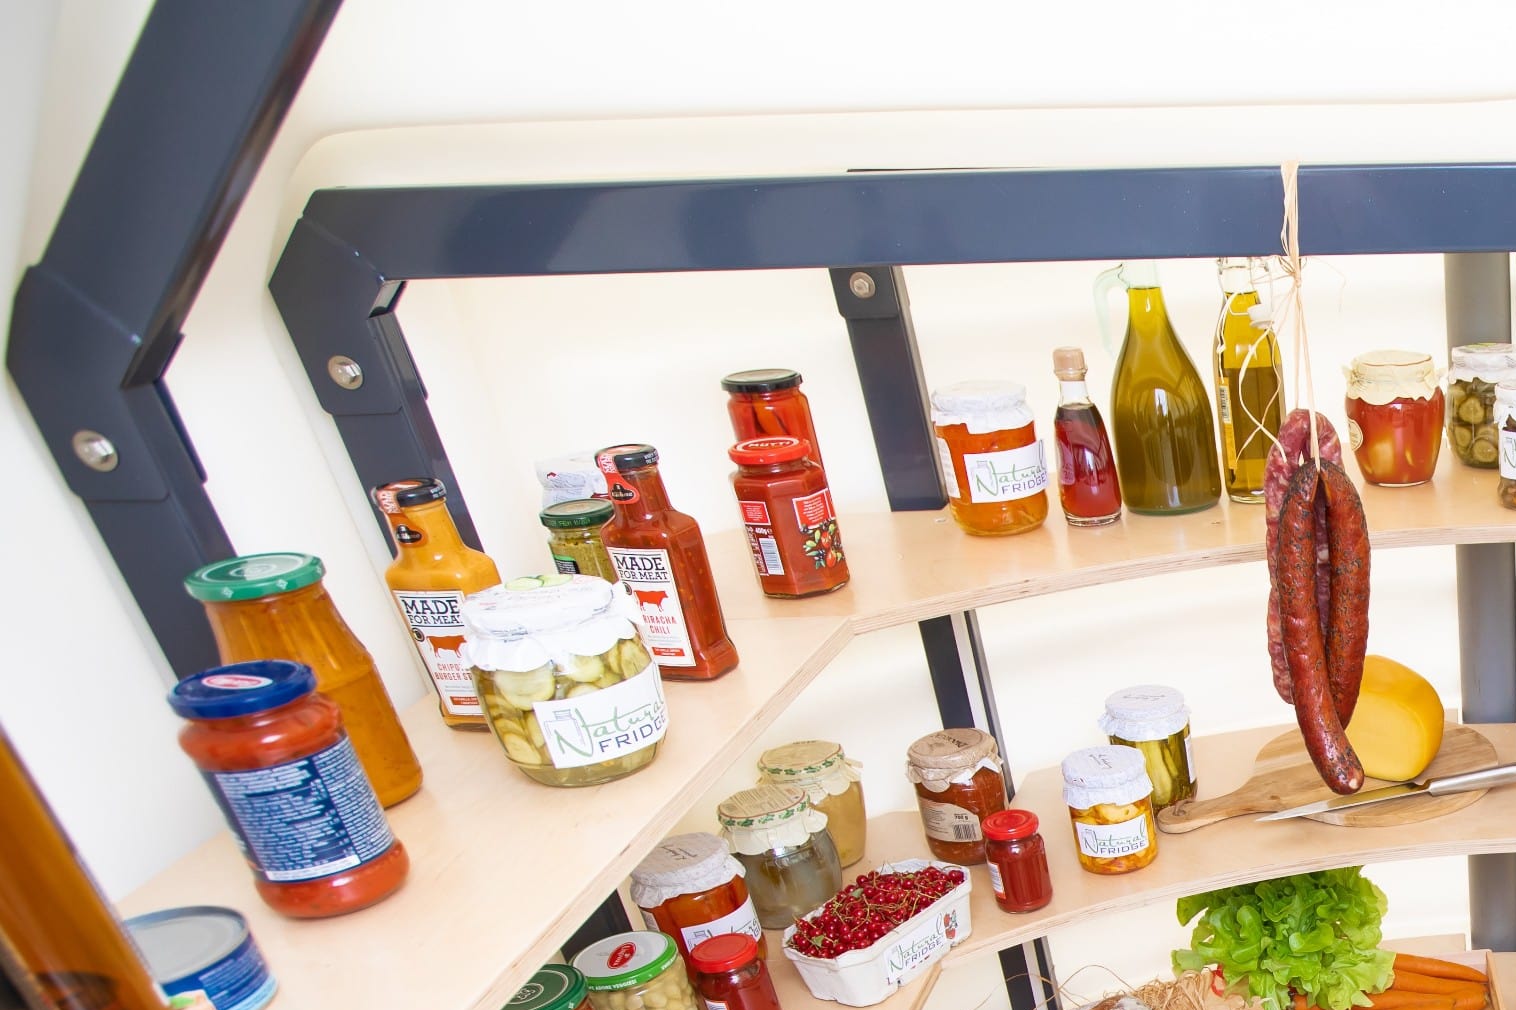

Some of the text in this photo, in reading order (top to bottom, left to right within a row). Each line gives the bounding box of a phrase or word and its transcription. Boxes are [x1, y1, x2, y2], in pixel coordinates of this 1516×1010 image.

[975, 439, 1047, 497] Natural
[614, 555, 665, 571] MADE
[620, 569, 669, 580] FOR MEAT
[402, 599, 460, 615] MADE
[408, 614, 430, 625] FOR
[649, 624, 671, 635] CHILI
[599, 712, 666, 753] FRIDGE
[1084, 815, 1147, 854] Natural
[1100, 840, 1147, 856] FRIDGE
[890, 913, 943, 973] Natural
[905, 940, 942, 967] FRIDGE
